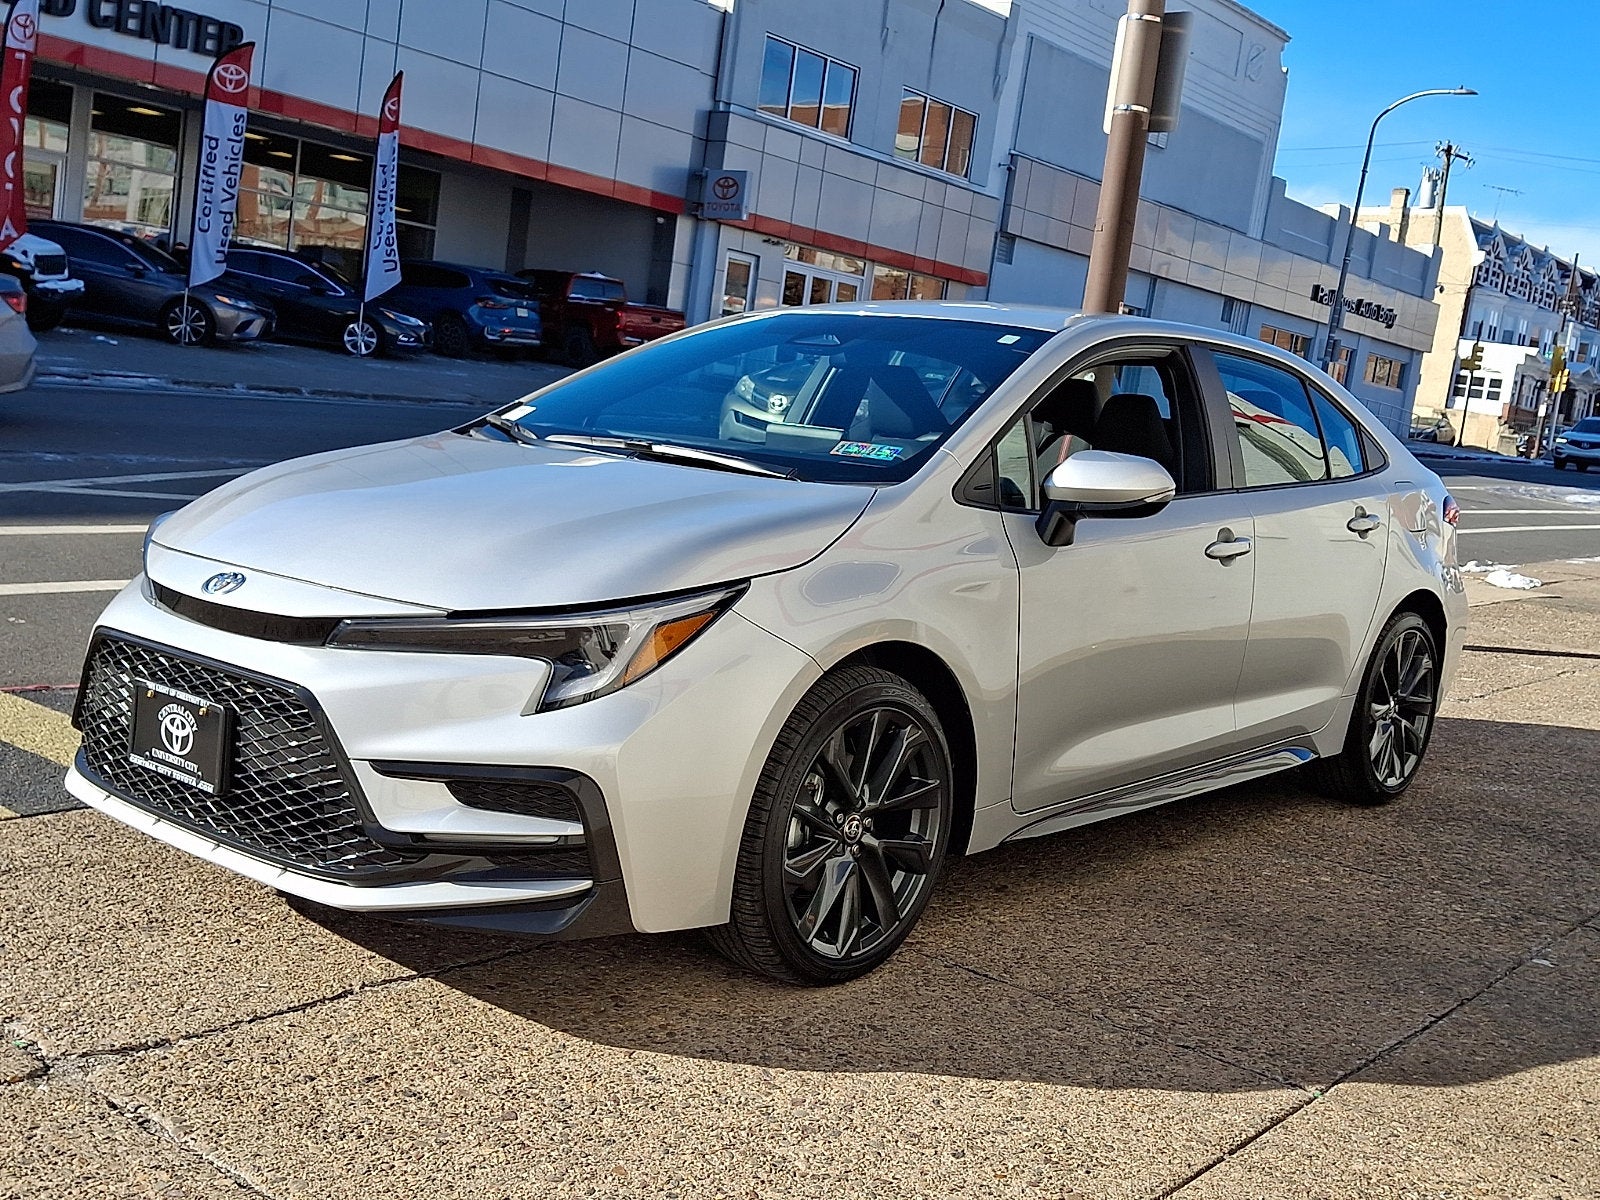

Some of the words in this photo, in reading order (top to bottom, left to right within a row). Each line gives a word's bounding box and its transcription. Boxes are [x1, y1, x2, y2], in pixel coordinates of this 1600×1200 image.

[86, 0, 244, 57] CENTER
[198, 135, 221, 233] Certified
[220, 112, 245, 204] Vehicles
[215, 210, 234, 264] Used
